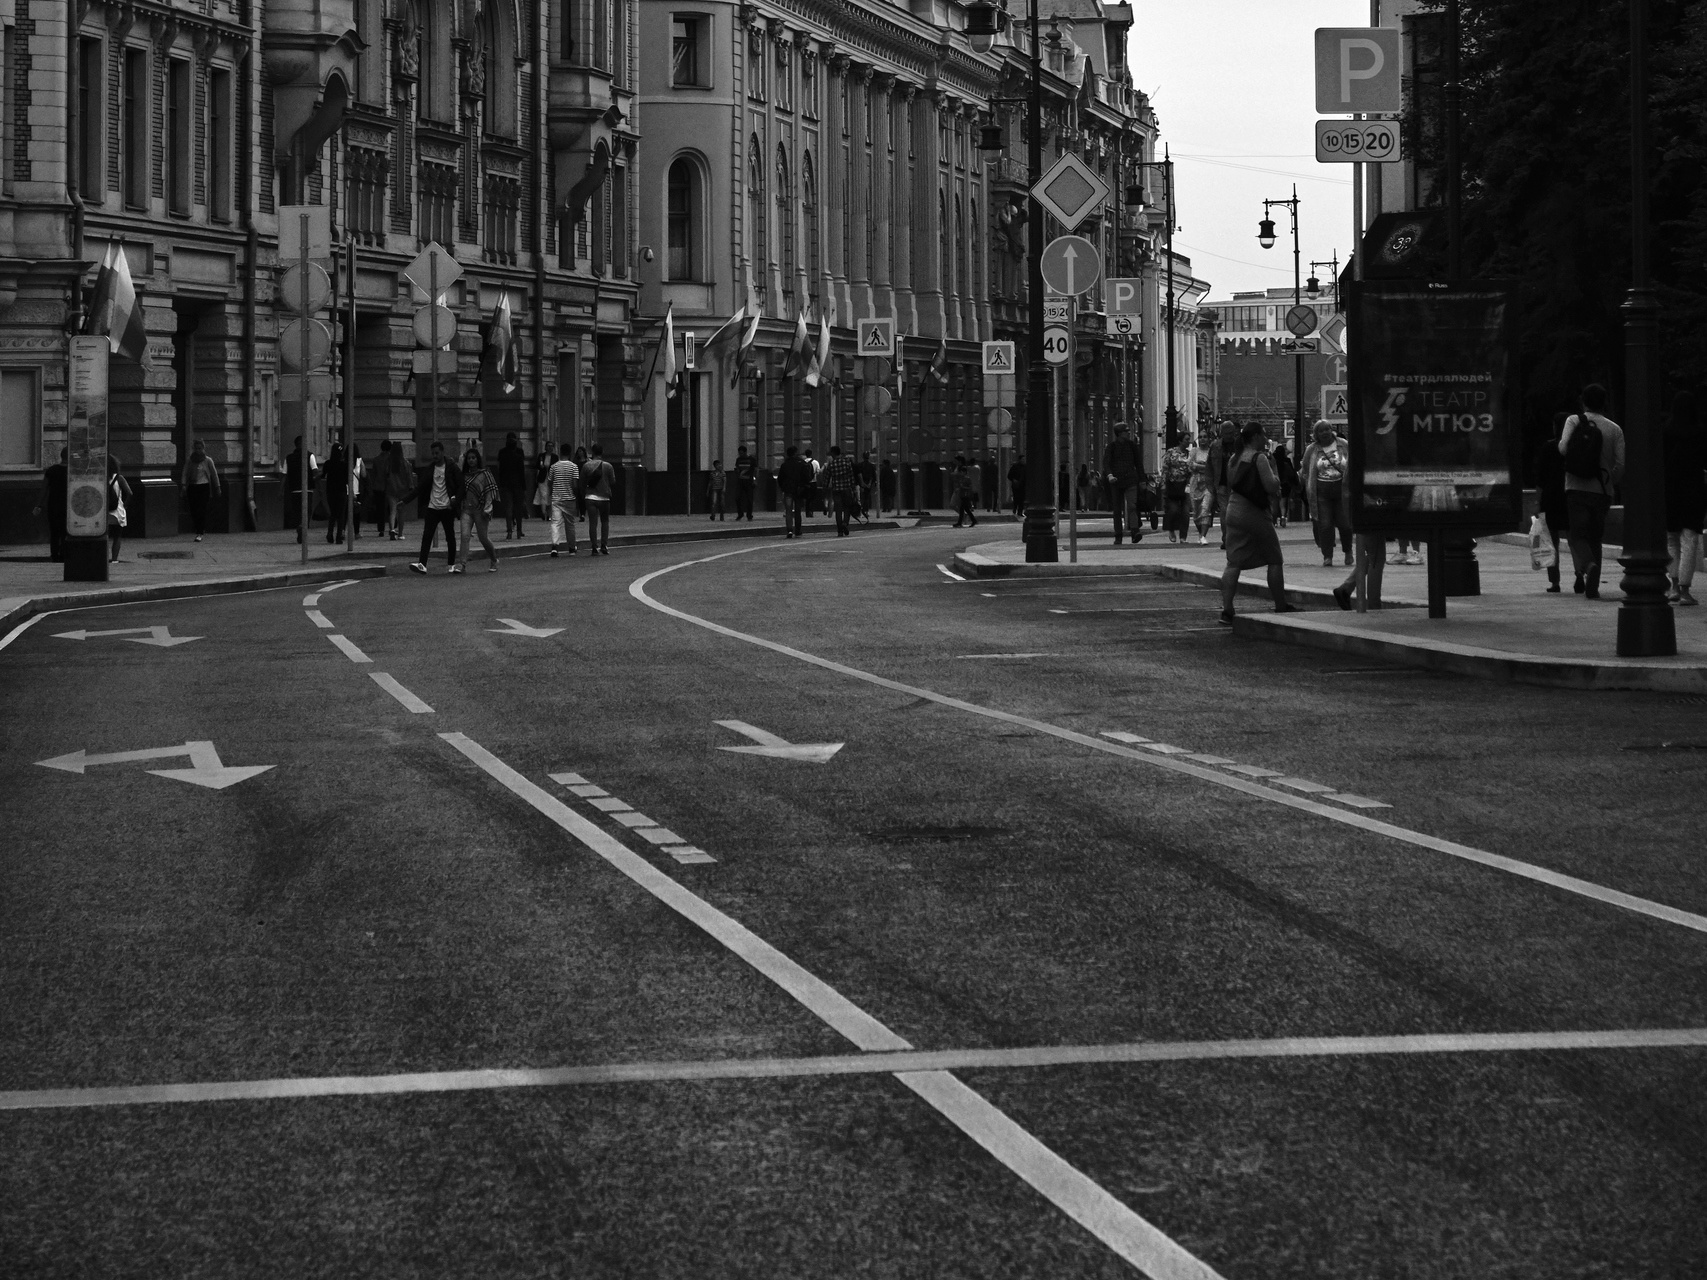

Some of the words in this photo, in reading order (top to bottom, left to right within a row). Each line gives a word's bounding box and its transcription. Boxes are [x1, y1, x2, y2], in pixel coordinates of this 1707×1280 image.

[1340, 38, 1385, 103] P
[1325, 135, 1339, 147] 10
[1343, 134, 1360, 148] 15
[1365, 132, 1391, 150] 20
[1115, 282, 1135, 311] P
[1048, 307, 1057, 316] 15
[1044, 336, 1068, 354] 40
[1384, 371, 1492, 386] #театрдлялюдей
[1418, 391, 1487, 407] ТЕАТР
[1412, 413, 1494, 433] МТЮЗ
